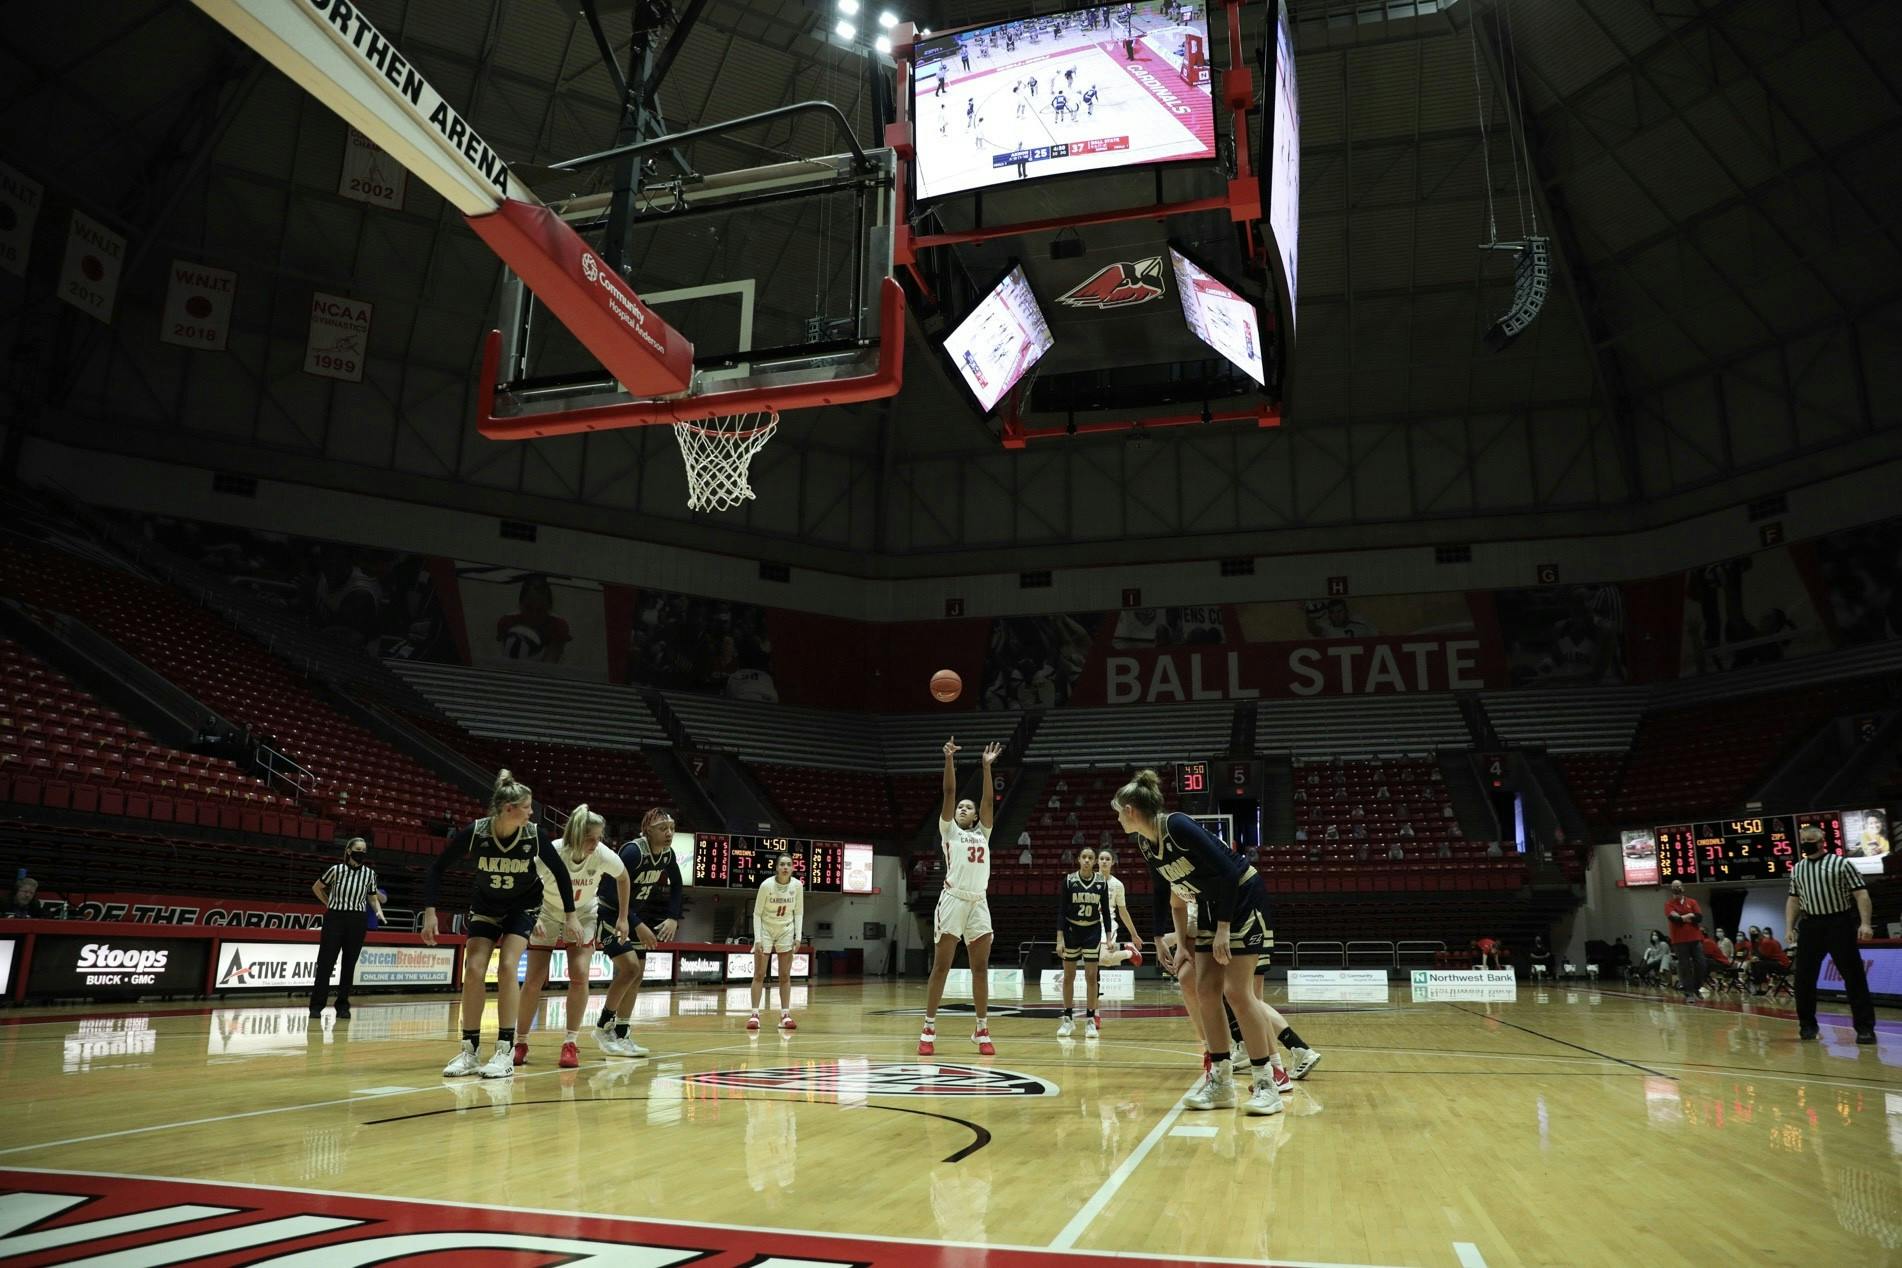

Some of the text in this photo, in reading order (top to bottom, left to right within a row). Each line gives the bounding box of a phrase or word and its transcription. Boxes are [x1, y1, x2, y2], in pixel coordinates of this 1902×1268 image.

[1126, 64, 1192, 114] CARDINALS
[429, 101, 508, 195] ARENA
[1034, 149, 1047, 159] 25
[1071, 143, 1084, 153] 37
[351, 178, 394, 200] 2002
[69, 281, 104, 307] 2017
[599, 272, 645, 325] Community
[314, 300, 369, 323] NCAA
[175, 324, 217, 341] 2018
[608, 298, 665, 354] Hospital Anderson
[314, 354, 357, 374] 1999
[1543, 569, 1555, 582] G
[1332, 582, 1344, 593] H
[1106, 640, 1485, 704] BALL STATE
[1490, 760, 1502, 775] 4
[994, 776, 1006, 791] 6
[1183, 774, 1202, 791] 30
[1233, 769, 1245, 784] 5
[1731, 819, 1762, 834] 4:50
[763, 839, 787, 851] 4:50
[1741, 845, 1749, 856] 2
[1773, 841, 1792, 856] 25
[968, 846, 985, 863] 32
[1705, 846, 1723, 860] 37
[478, 856, 530, 873] AKRON
[738, 857, 753, 869] 37
[768, 859, 774, 869] 2
[1720, 865, 1729, 874] 4
[1767, 861, 1776, 873] 3
[489, 874, 515, 889] 33
[748, 874, 755, 883] 4
[132, 904, 201, 926] THE
[776, 905, 787, 917] 11
[1077, 904, 1093, 917] 20
[77, 943, 169, 970] Stoops
[218, 945, 288, 985] ACTIVE
[86, 974, 156, 985] BUICK GMC
[1429, 973, 1483, 982] Northwest
[1487, 973, 1513, 982] Bank
